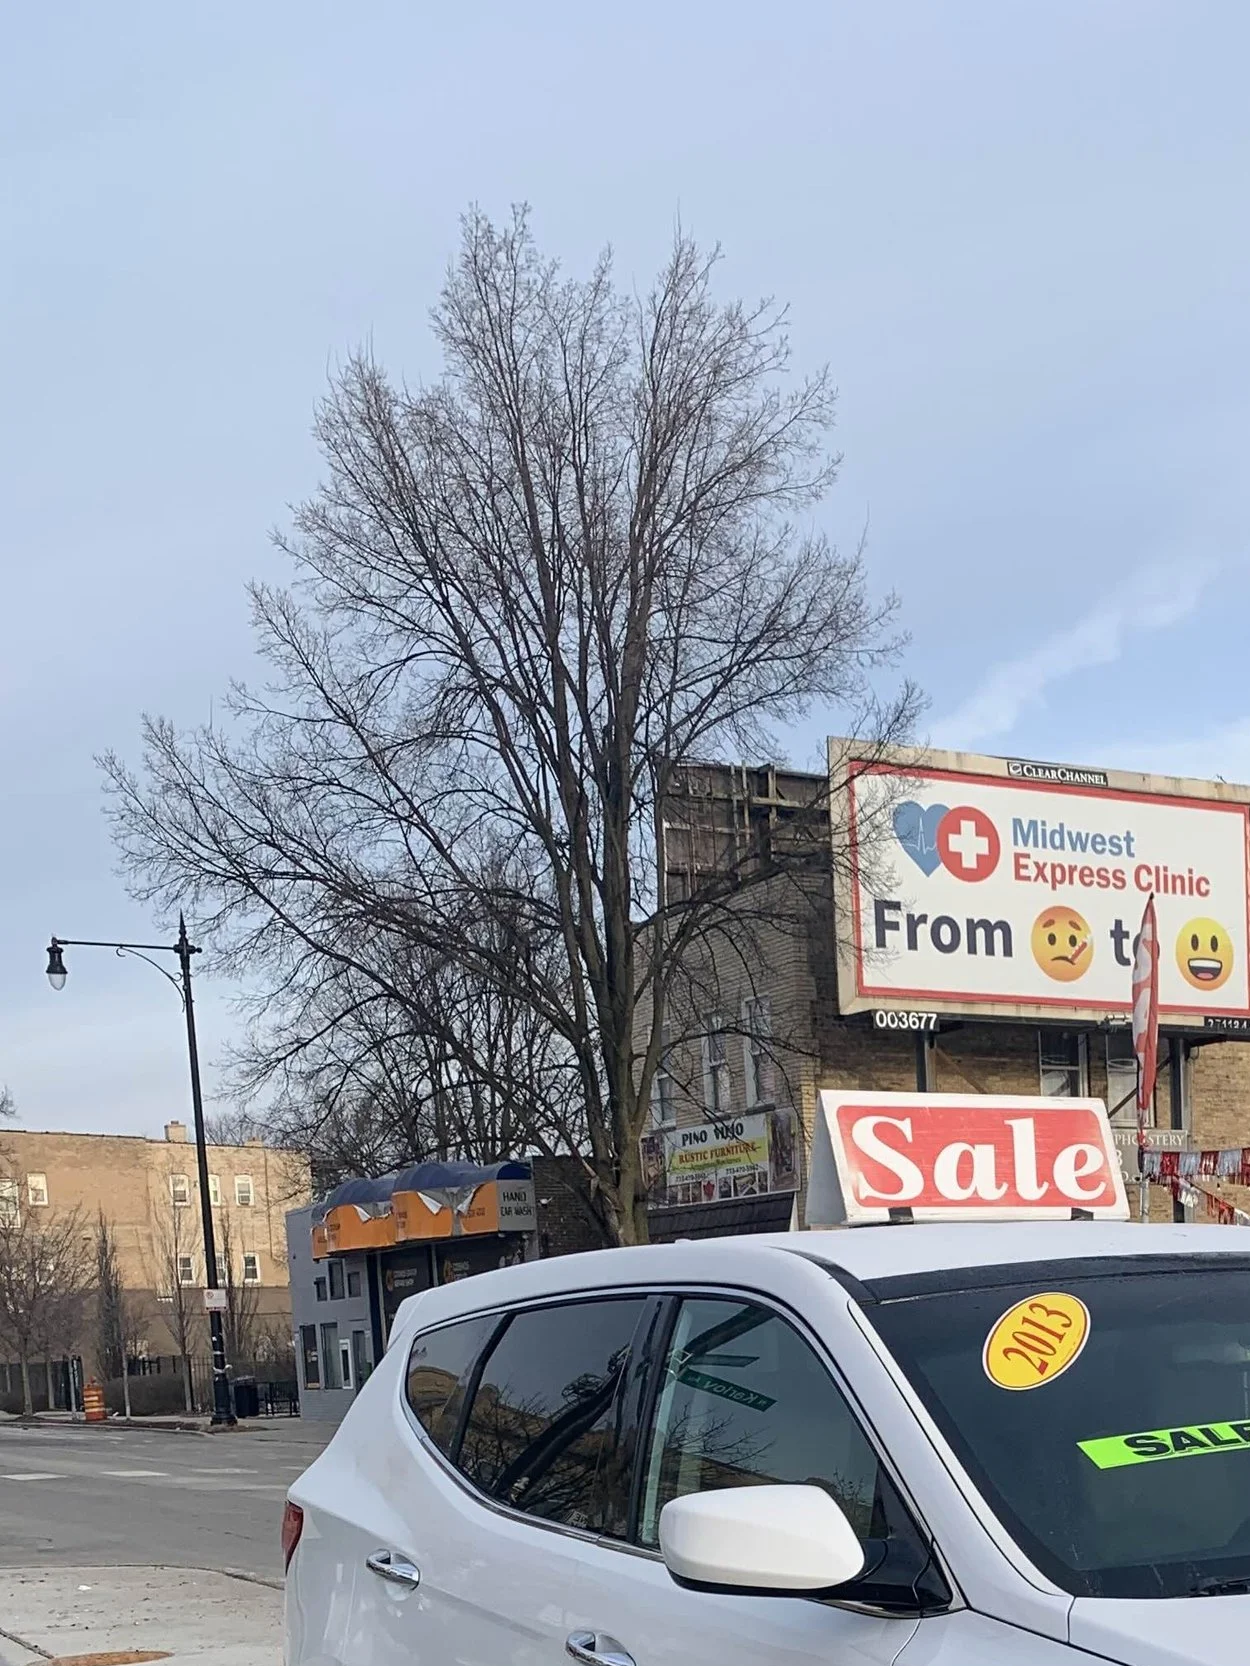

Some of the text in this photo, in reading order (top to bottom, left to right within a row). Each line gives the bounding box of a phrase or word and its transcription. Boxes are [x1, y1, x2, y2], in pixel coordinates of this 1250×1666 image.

[1012, 817, 1135, 858] Midwest
[1014, 853, 1210, 898] Express Clinic
[874, 900, 1160, 967] From t
[875, 1010, 937, 1030] 003677
[679, 1150, 710, 1165] RUSTIC
[852, 1115, 1106, 1201] Sale
[1002, 1302, 1073, 1376] 2013
